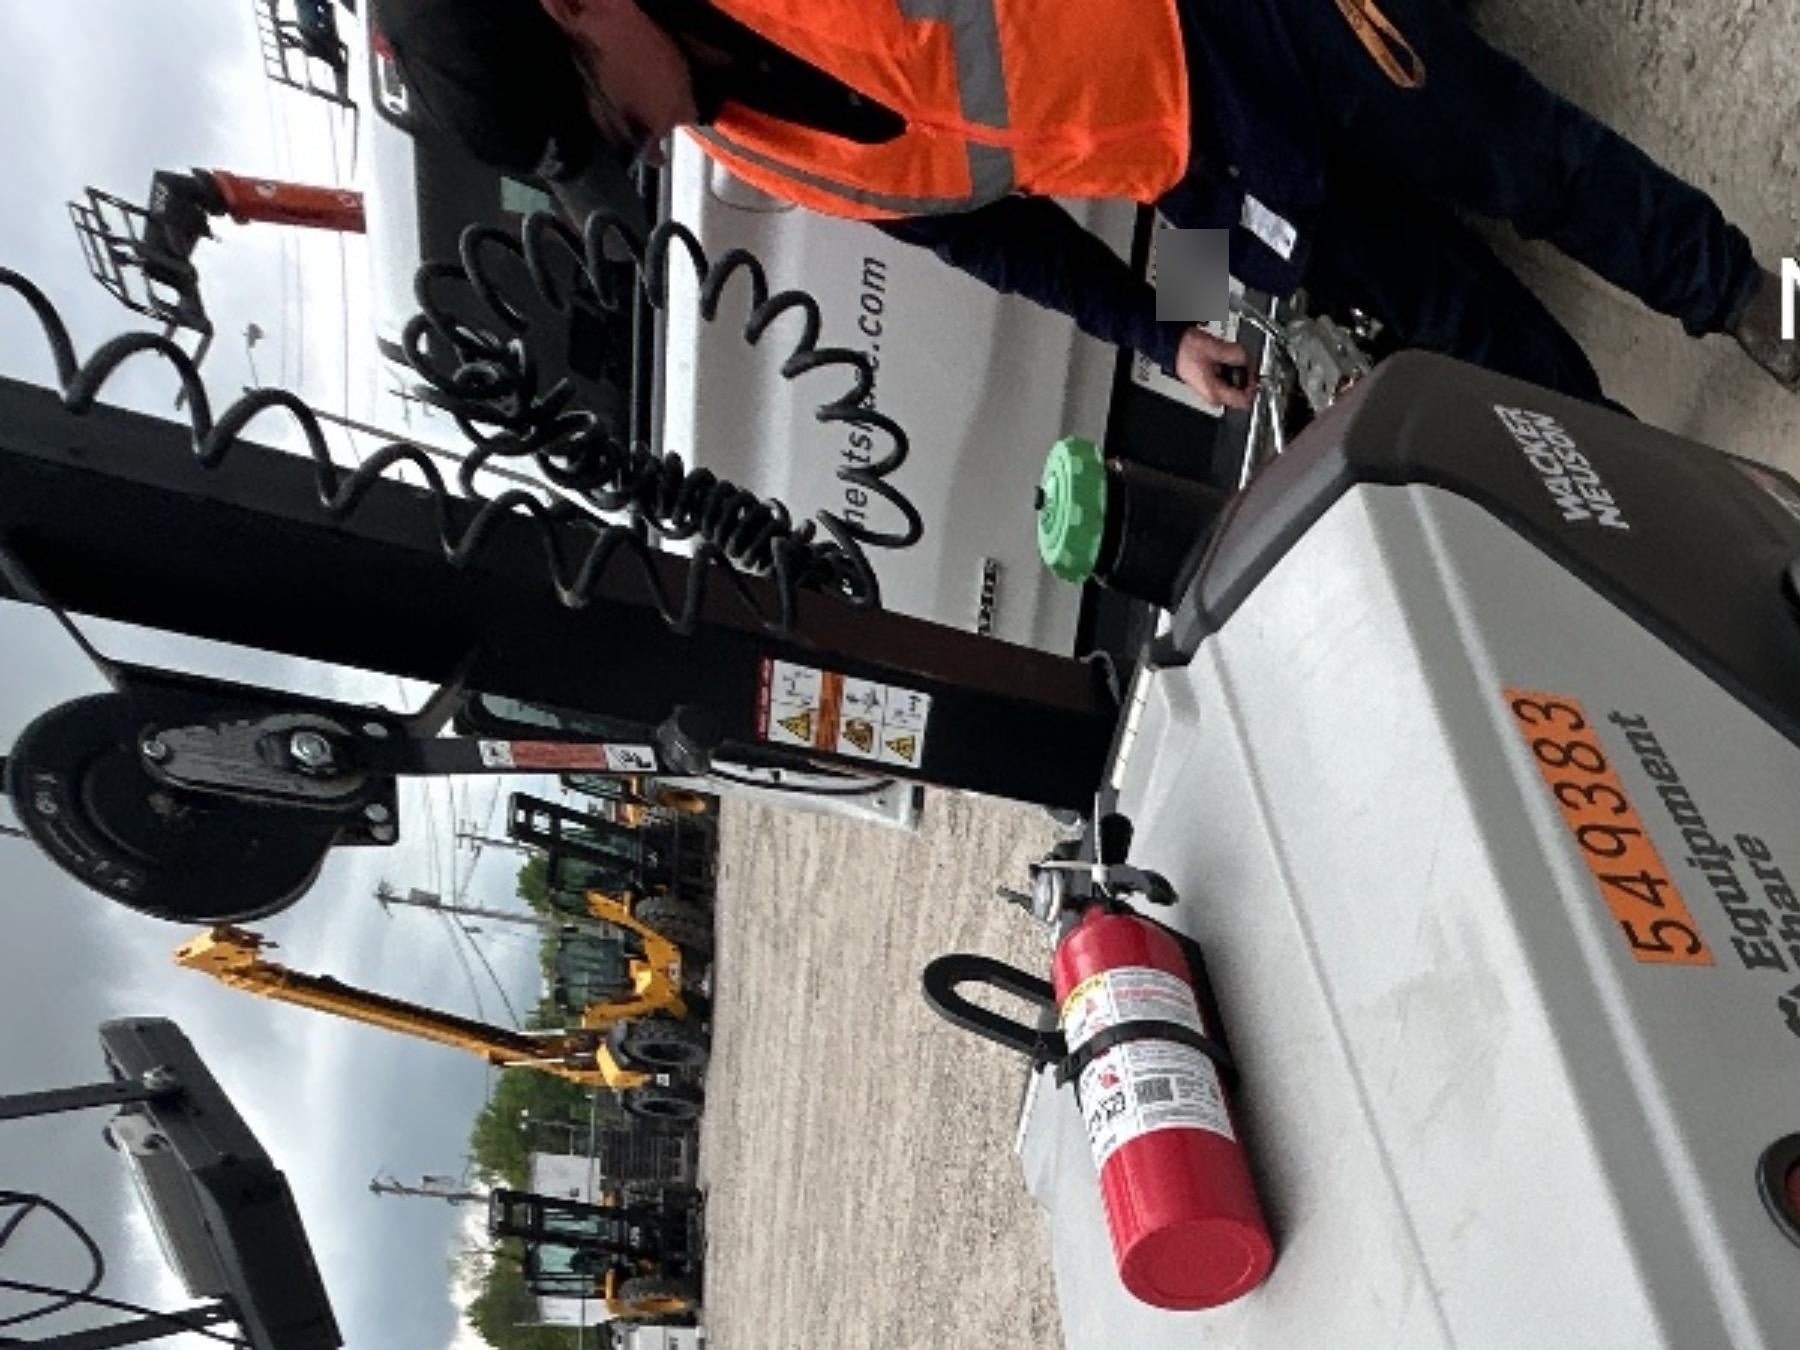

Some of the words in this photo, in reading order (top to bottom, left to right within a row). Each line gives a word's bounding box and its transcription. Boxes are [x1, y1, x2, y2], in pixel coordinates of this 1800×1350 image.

[1493, 404, 1590, 521] WACKER
[1524, 410, 1629, 529] NEUSON
[1511, 698, 1702, 956] 549383
[1608, 710, 1789, 972] Equipment
